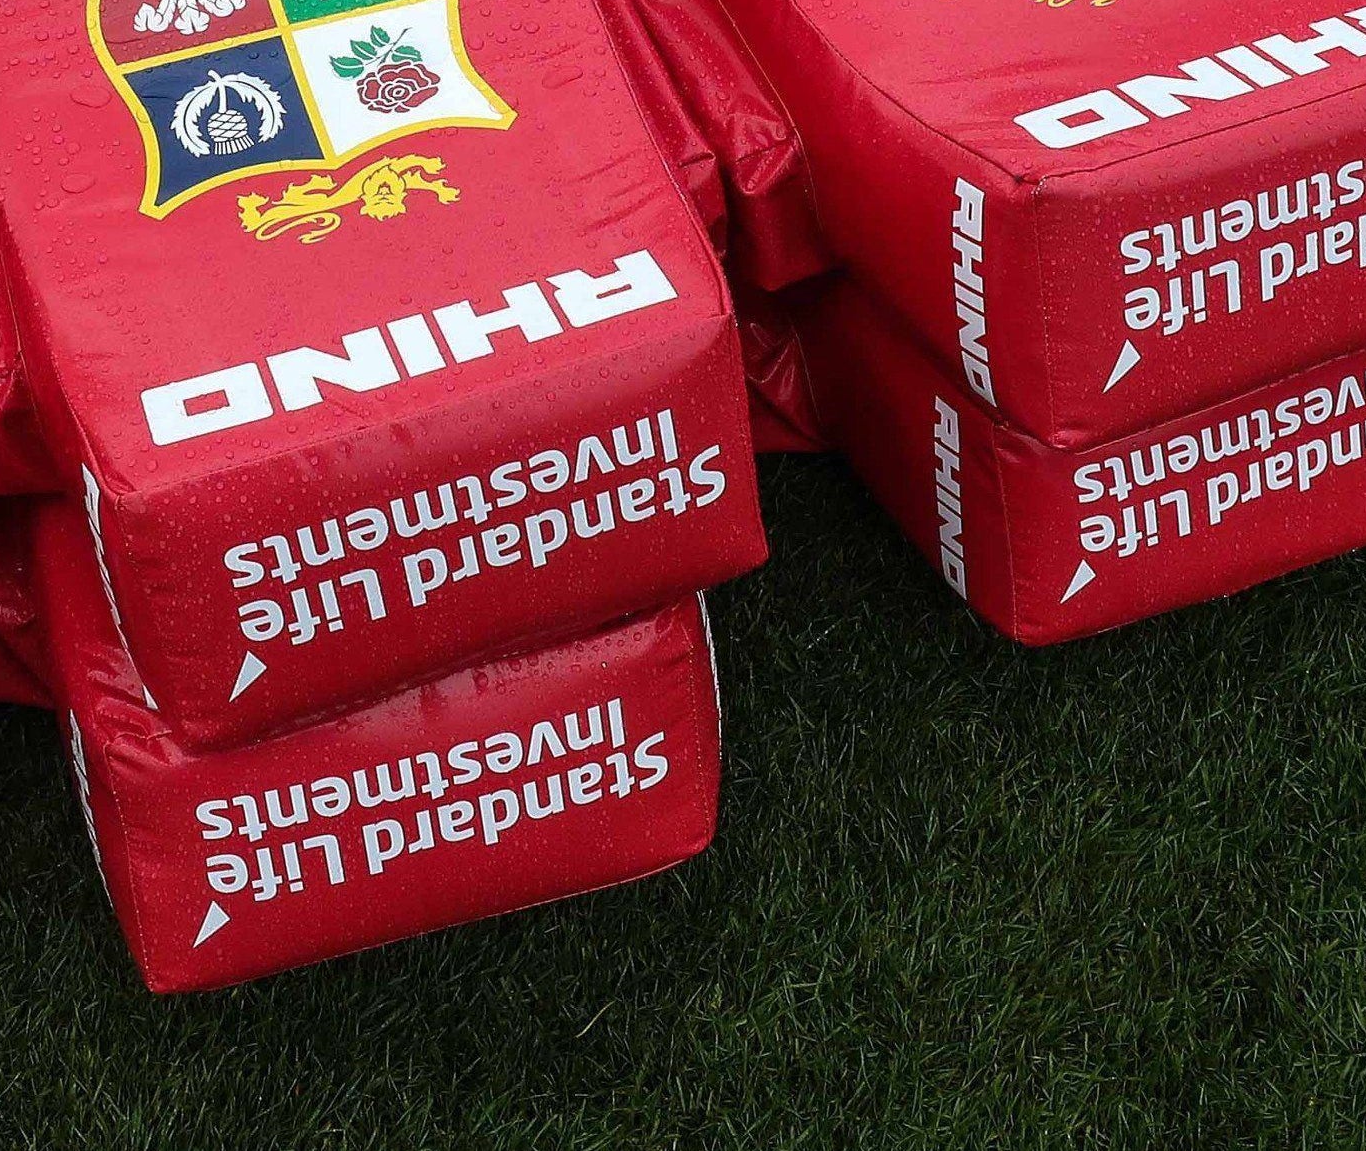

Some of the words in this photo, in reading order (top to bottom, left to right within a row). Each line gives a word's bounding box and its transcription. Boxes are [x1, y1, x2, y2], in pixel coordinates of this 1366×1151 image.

[140, 249, 678, 447] RHINO
[951, 176, 997, 408] RHINO
[1123, 260, 1242, 336] Life
[224, 408, 679, 590] Investments
[403, 445, 727, 607] Standard
[934, 395, 967, 601] RHINO
[1078, 487, 1191, 559] Life
[238, 567, 387, 646] Life
[194, 697, 627, 842] Investments
[361, 731, 670, 877] Standard
[205, 833, 348, 904] Life
